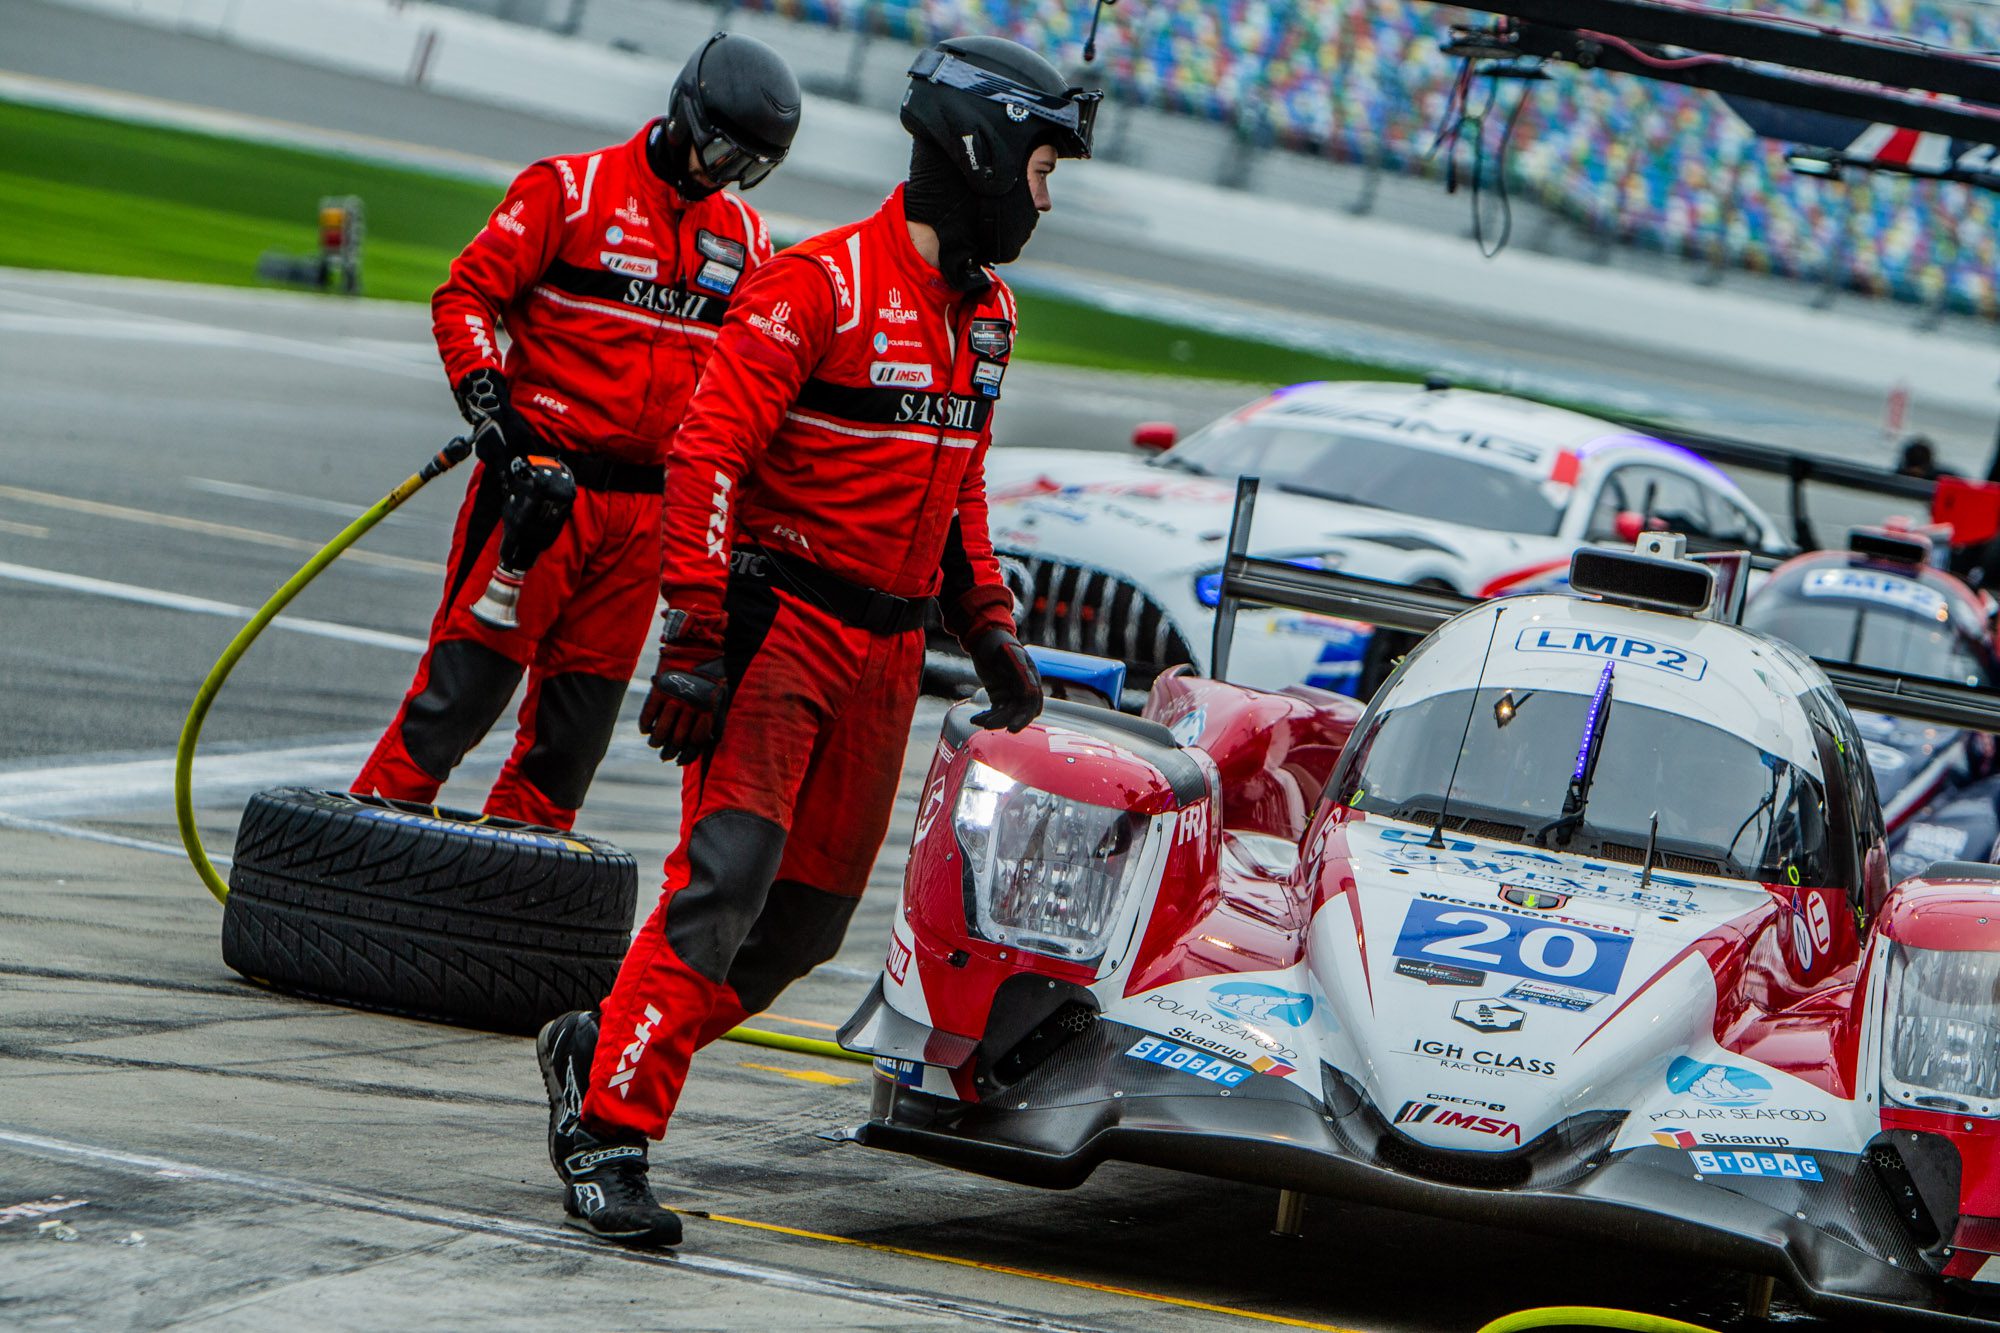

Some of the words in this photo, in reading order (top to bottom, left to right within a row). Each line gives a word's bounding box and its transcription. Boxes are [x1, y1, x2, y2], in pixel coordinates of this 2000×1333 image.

[622, 261, 652, 274] IMSA
[747, 313, 773, 330] HIGH
[773, 323, 800, 346] CLASS
[878, 308, 895, 320] HIGH
[895, 310, 918, 321] CLASS
[895, 370, 927, 382] IMSA
[533, 393, 568, 413] HRX
[894, 393, 977, 429] SASSHI
[1537, 630, 1688, 672] LMP2
[1419, 891, 1631, 936] WeatherTech
[1808, 897, 1829, 949] E
[1421, 911, 1598, 978] 20
[1144, 994, 1212, 1024] POLAR
[1211, 1020, 1298, 1060] SEAFOOD
[1168, 1026, 1248, 1060] Skaarup
[608, 1003, 663, 1100] HRX
[1134, 1042, 1244, 1084] STOBAG
[1414, 1038, 1464, 1060] IGH
[1472, 1050, 1556, 1075] CLASS
[1440, 1060, 1505, 1077] RACING
[1426, 1093, 1487, 1107] ORECA
[1649, 1108, 1725, 1122] POLAR
[1729, 1108, 1827, 1122] SEAFOOD
[1432, 1110, 1521, 1146] IMSA
[1701, 1132, 1790, 1148] Skaarup
[1699, 1156, 1817, 1174] STOBAG
